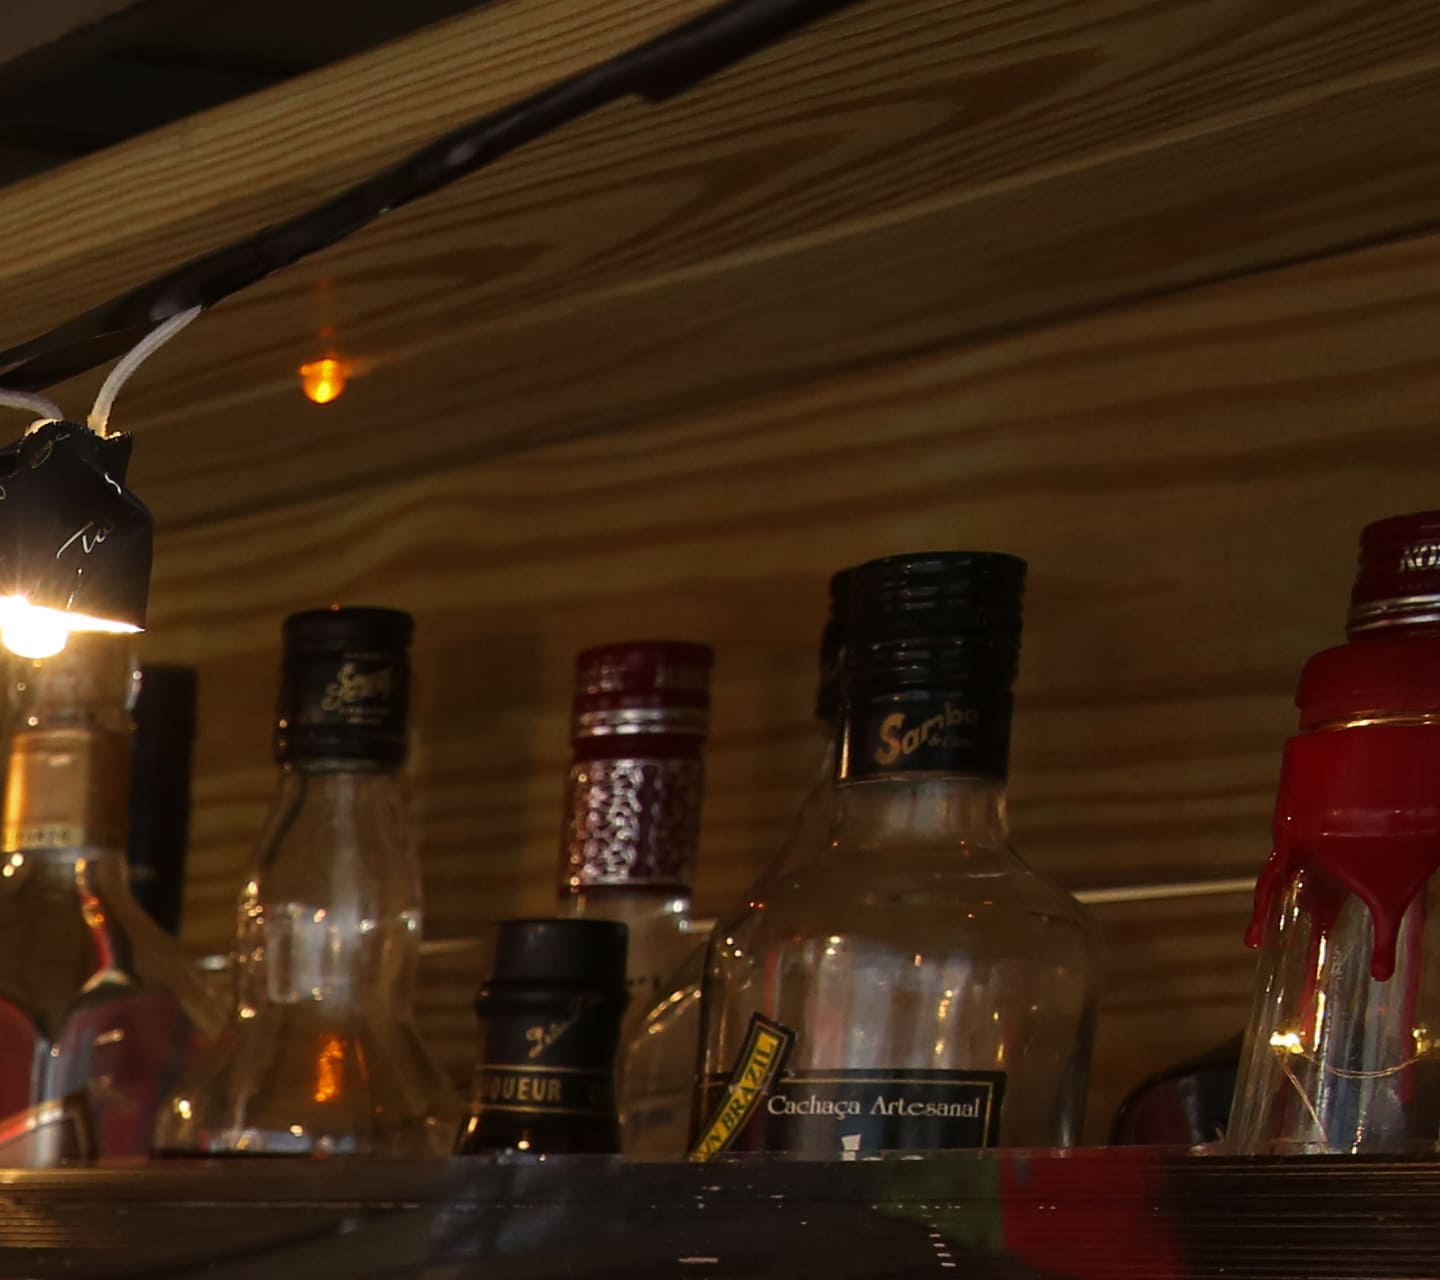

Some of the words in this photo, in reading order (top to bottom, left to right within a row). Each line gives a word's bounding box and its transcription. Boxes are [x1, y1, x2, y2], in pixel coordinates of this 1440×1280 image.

[718, 1039, 775, 1132] BRAZIL
[768, 1096, 861, 1120] Cachaça
[870, 1096, 980, 1118] Artesanal
